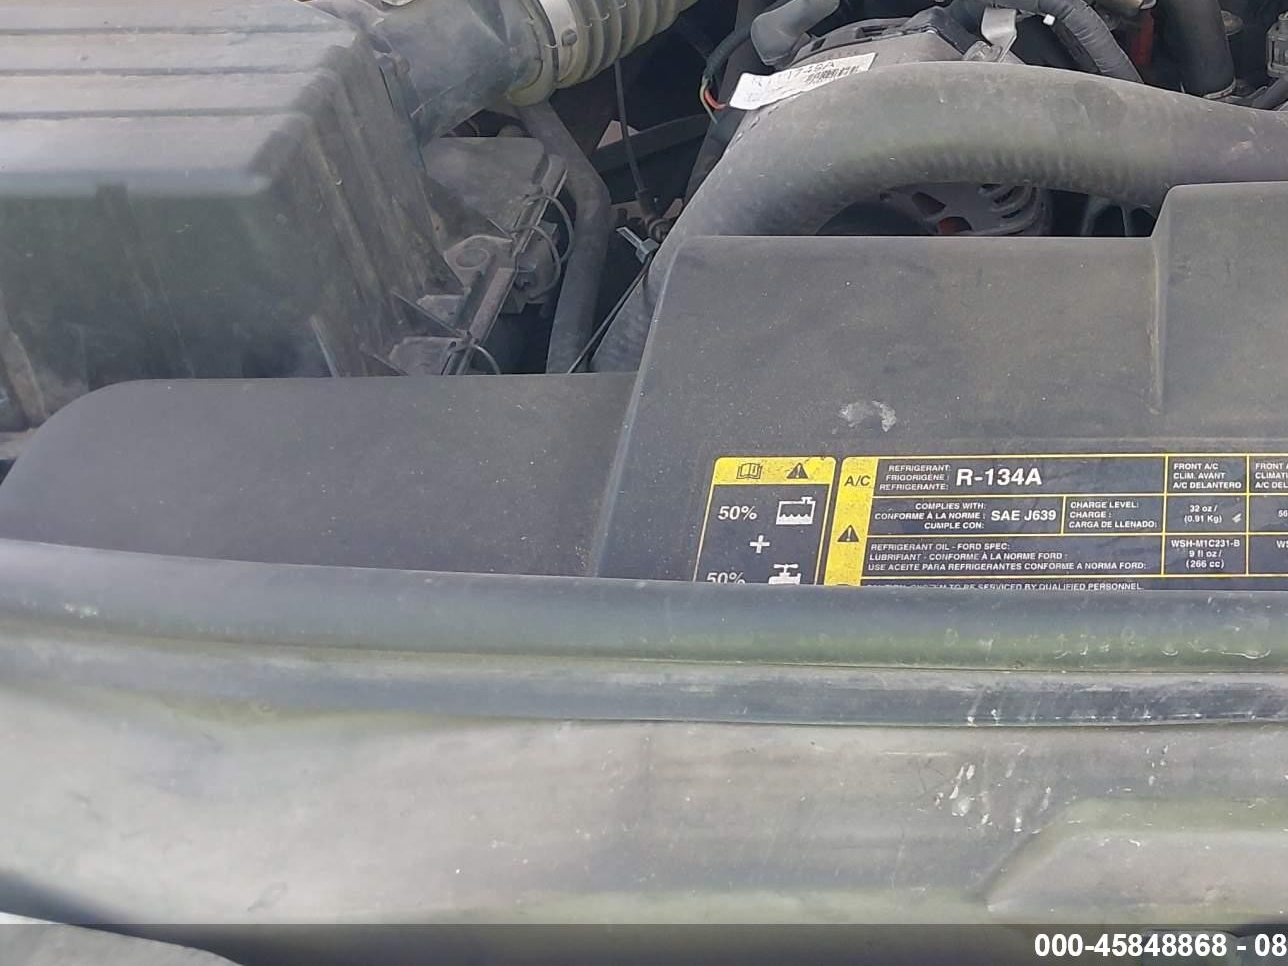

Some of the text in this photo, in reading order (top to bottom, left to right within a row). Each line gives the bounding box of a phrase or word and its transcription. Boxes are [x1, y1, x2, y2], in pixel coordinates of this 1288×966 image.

[888, 464, 952, 472] REFRIGERANT:
[844, 475, 871, 487] A/C
[956, 468, 1043, 486] R-134A
[879, 483, 949, 491] REFRIGERANTE:
[1173, 481, 1242, 489] A/C DELANTERO
[1255, 481, 1270, 489] A/C
[915, 502, 987, 510] COMPLIES WITH:
[1070, 501, 1139, 509] CHARGE LEVEL:
[717, 506, 757, 520] 50%
[948, 512, 980, 520] NORME
[991, 509, 1057, 521] SAE J639
[1184, 514, 1223, 523] (0.91 Kg)
[1069, 521, 1100, 529] CARGA
[1114, 520, 1158, 528] LLENADO:
[871, 543, 933, 551] REFRIGERANT
[935, 543, 950, 551] OIL
[1171, 539, 1241, 548] WSH-M1C231-B
[869, 553, 922, 561] LUBRIFIANT
[929, 553, 979, 561] CONFORME
[921, 563, 946, 571] PARA
[948, 563, 1022, 571] REFRIGERANTES
[1024, 562, 1075, 570] CONFORME
[1084, 562, 1118, 570] NORMA
[1119, 562, 1147, 570] FORD:
[1185, 559, 1225, 569] (266 cc)
[706, 572, 745, 584] 50%
